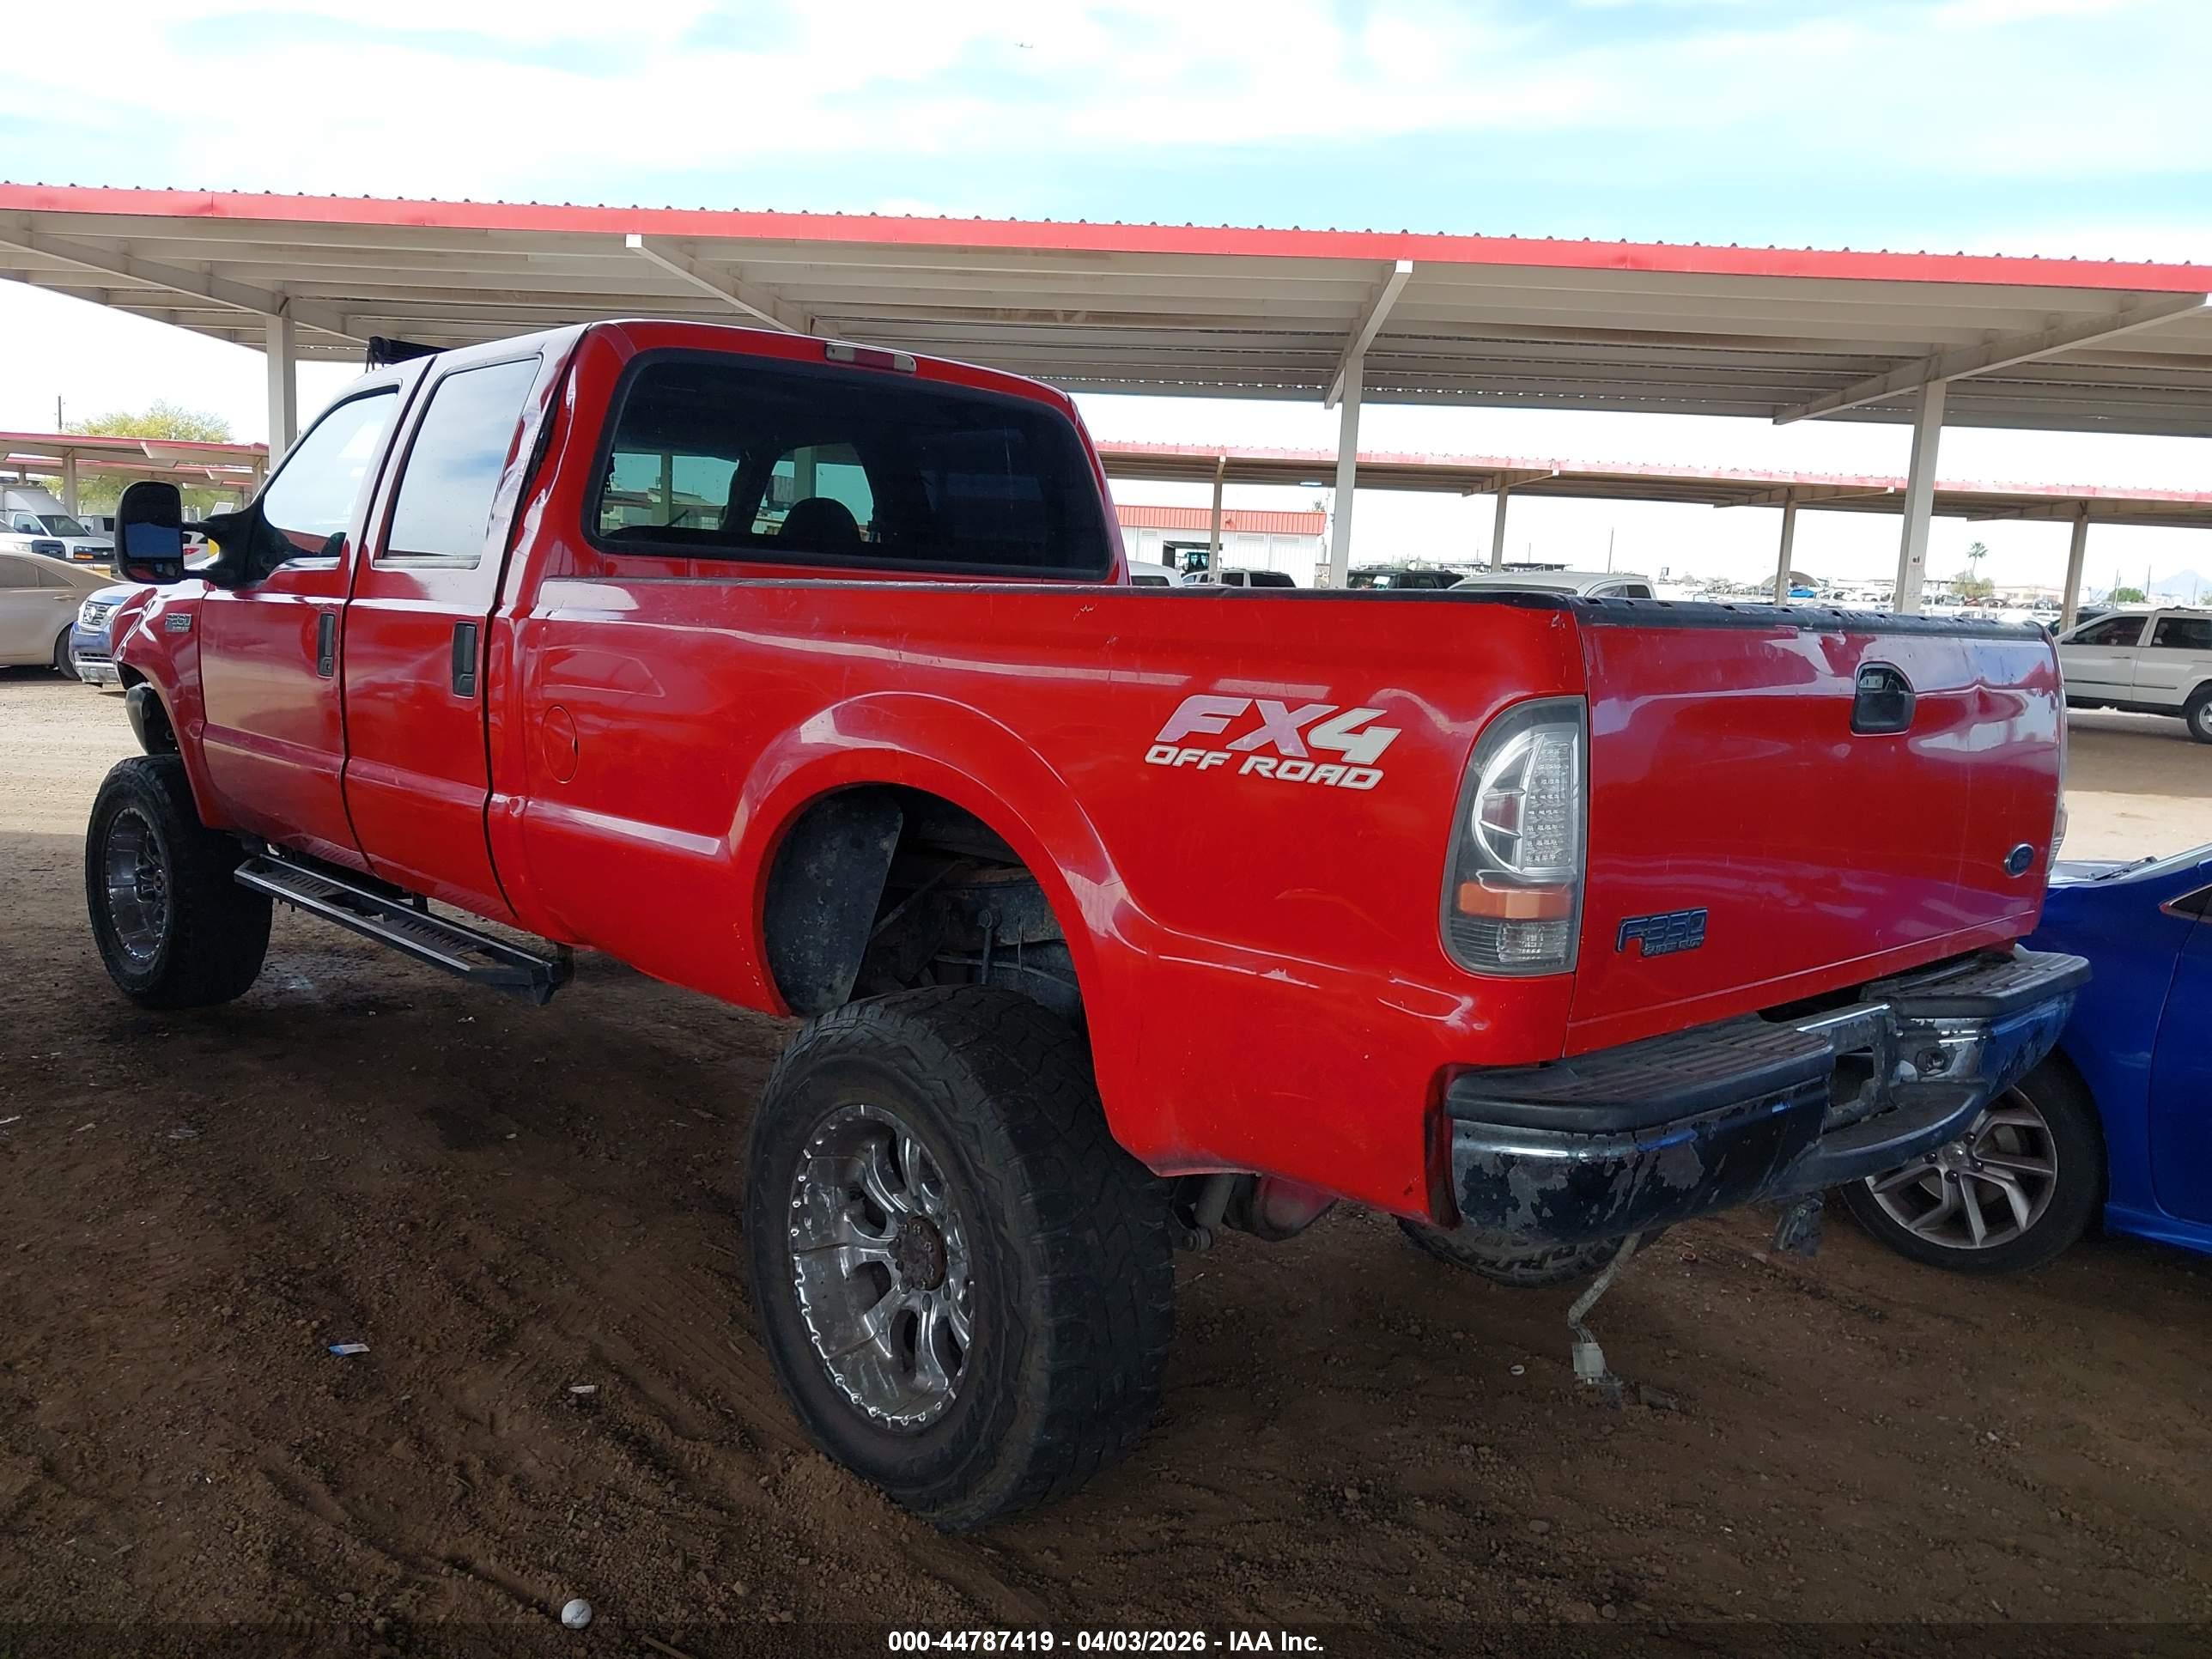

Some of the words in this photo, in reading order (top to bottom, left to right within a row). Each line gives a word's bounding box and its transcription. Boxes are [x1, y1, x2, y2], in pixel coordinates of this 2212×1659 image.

[1154, 694, 1402, 765] FX4
[1145, 744, 1233, 770] OFF
[1237, 755, 1384, 791] ROAD
